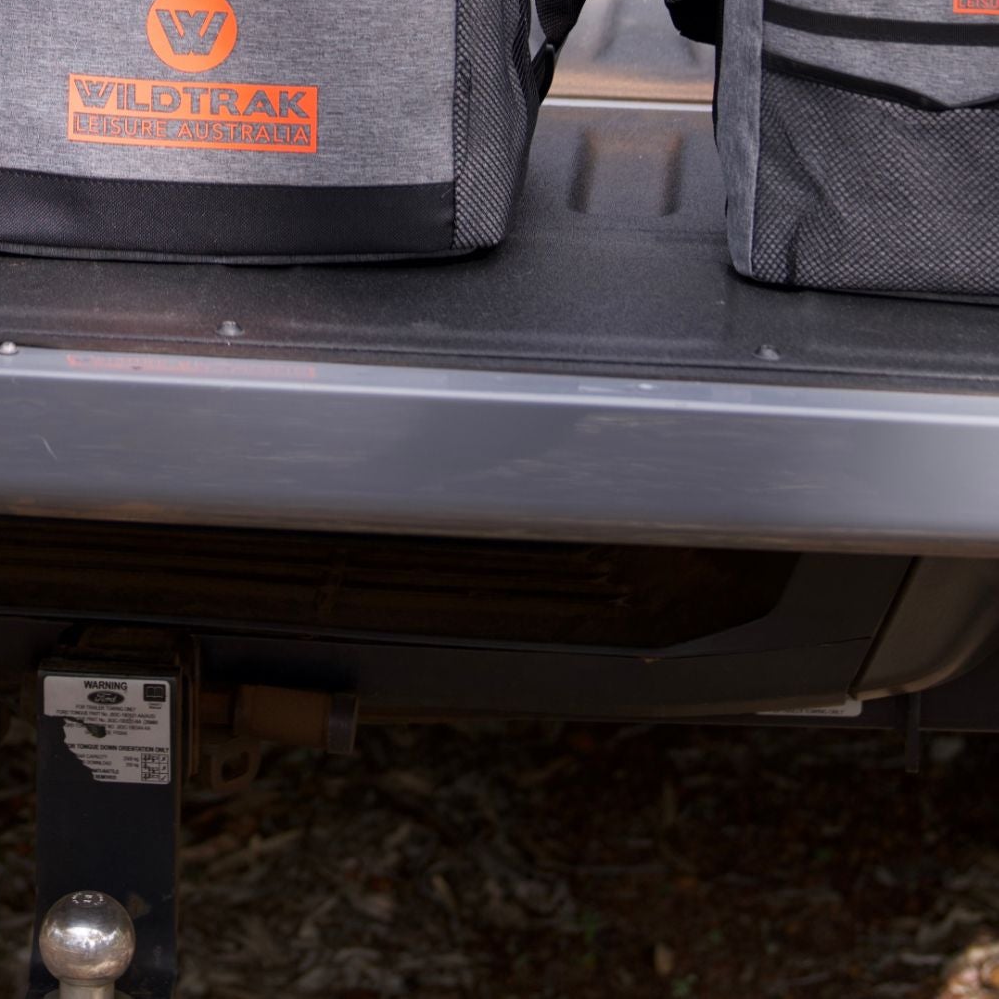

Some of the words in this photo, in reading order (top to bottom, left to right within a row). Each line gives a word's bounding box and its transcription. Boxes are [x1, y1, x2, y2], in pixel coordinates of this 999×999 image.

[74, 79, 310, 119] WILDTRAK
[74, 114, 167, 138] LEISURE
[177, 120, 310, 144] AUSTRALIA
[83, 680, 128, 691] WARNING
[94, 693, 118, 703] Ford
